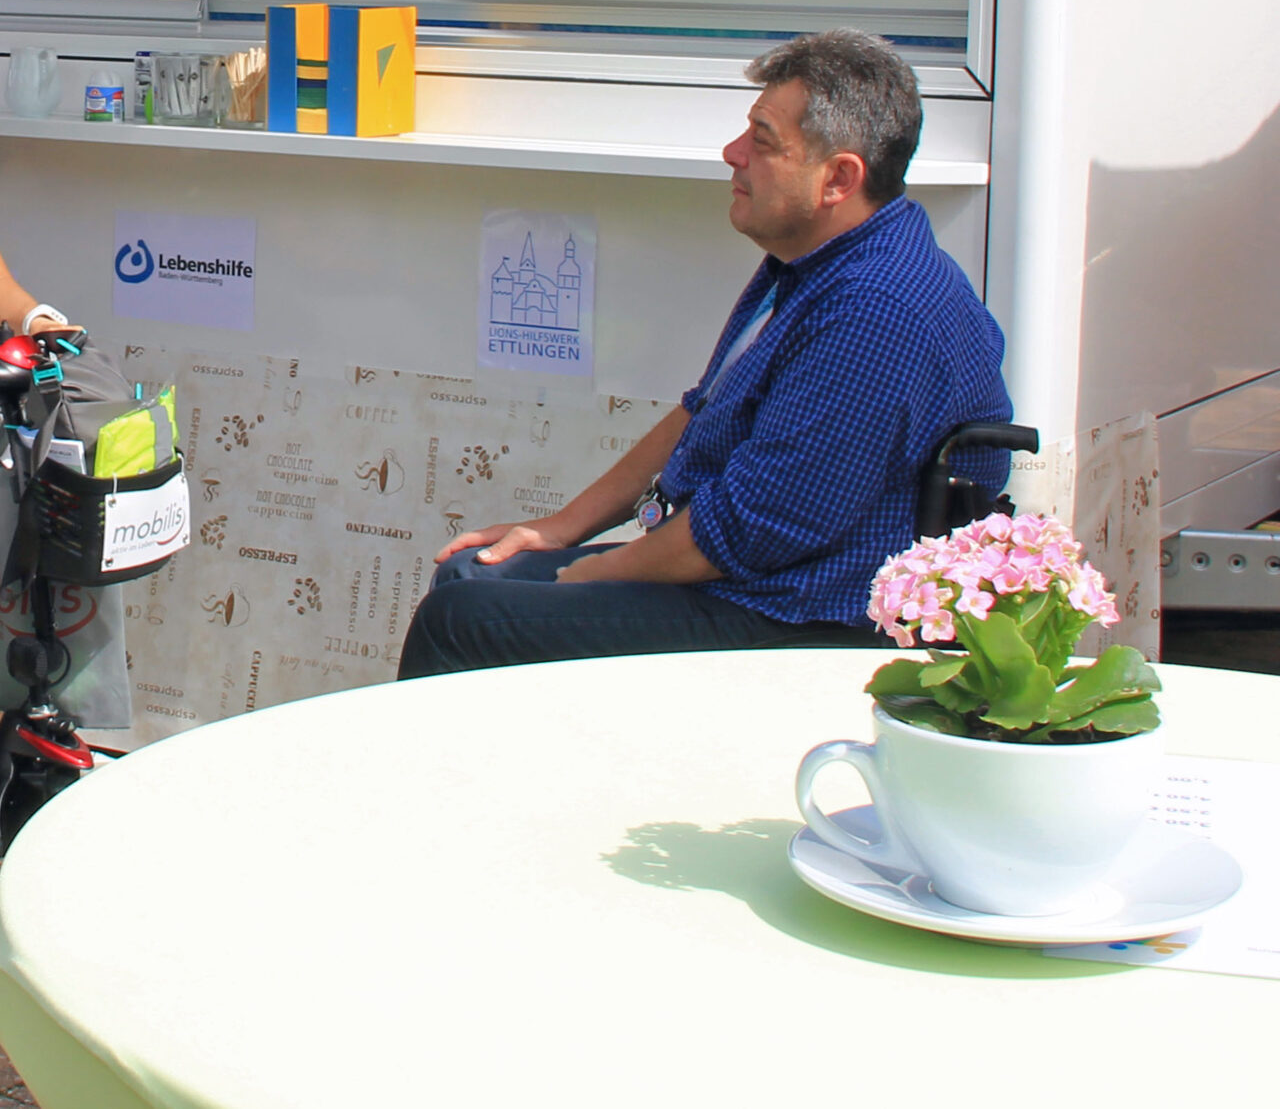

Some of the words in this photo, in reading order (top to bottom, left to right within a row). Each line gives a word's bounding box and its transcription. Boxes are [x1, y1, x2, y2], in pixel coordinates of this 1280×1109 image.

[158, 253, 253, 278] Lebenshilfe
[489, 327, 580, 345] LIONS-HILFSWERK
[488, 339, 580, 361] ETTLINGEN
[192, 363, 244, 378] espresso
[430, 391, 487, 407] espresso
[185, 407, 201, 472] ESPRESSO
[273, 470, 339, 487] cappuccino
[424, 437, 440, 504] ESPRESSO
[112, 502, 183, 544] mobilis
[247, 505, 314, 521] cappuccino
[345, 522, 413, 541] CAPPUCCINO
[239, 546, 298, 565] ESPRESSO
[368, 555, 382, 619] espresso
[348, 570, 361, 633] espresso
[389, 571, 403, 635] espresso
[136, 682, 185, 699] espresso
[246, 650, 262, 713] CAPPUCCI
[145, 703, 197, 722] espresso
